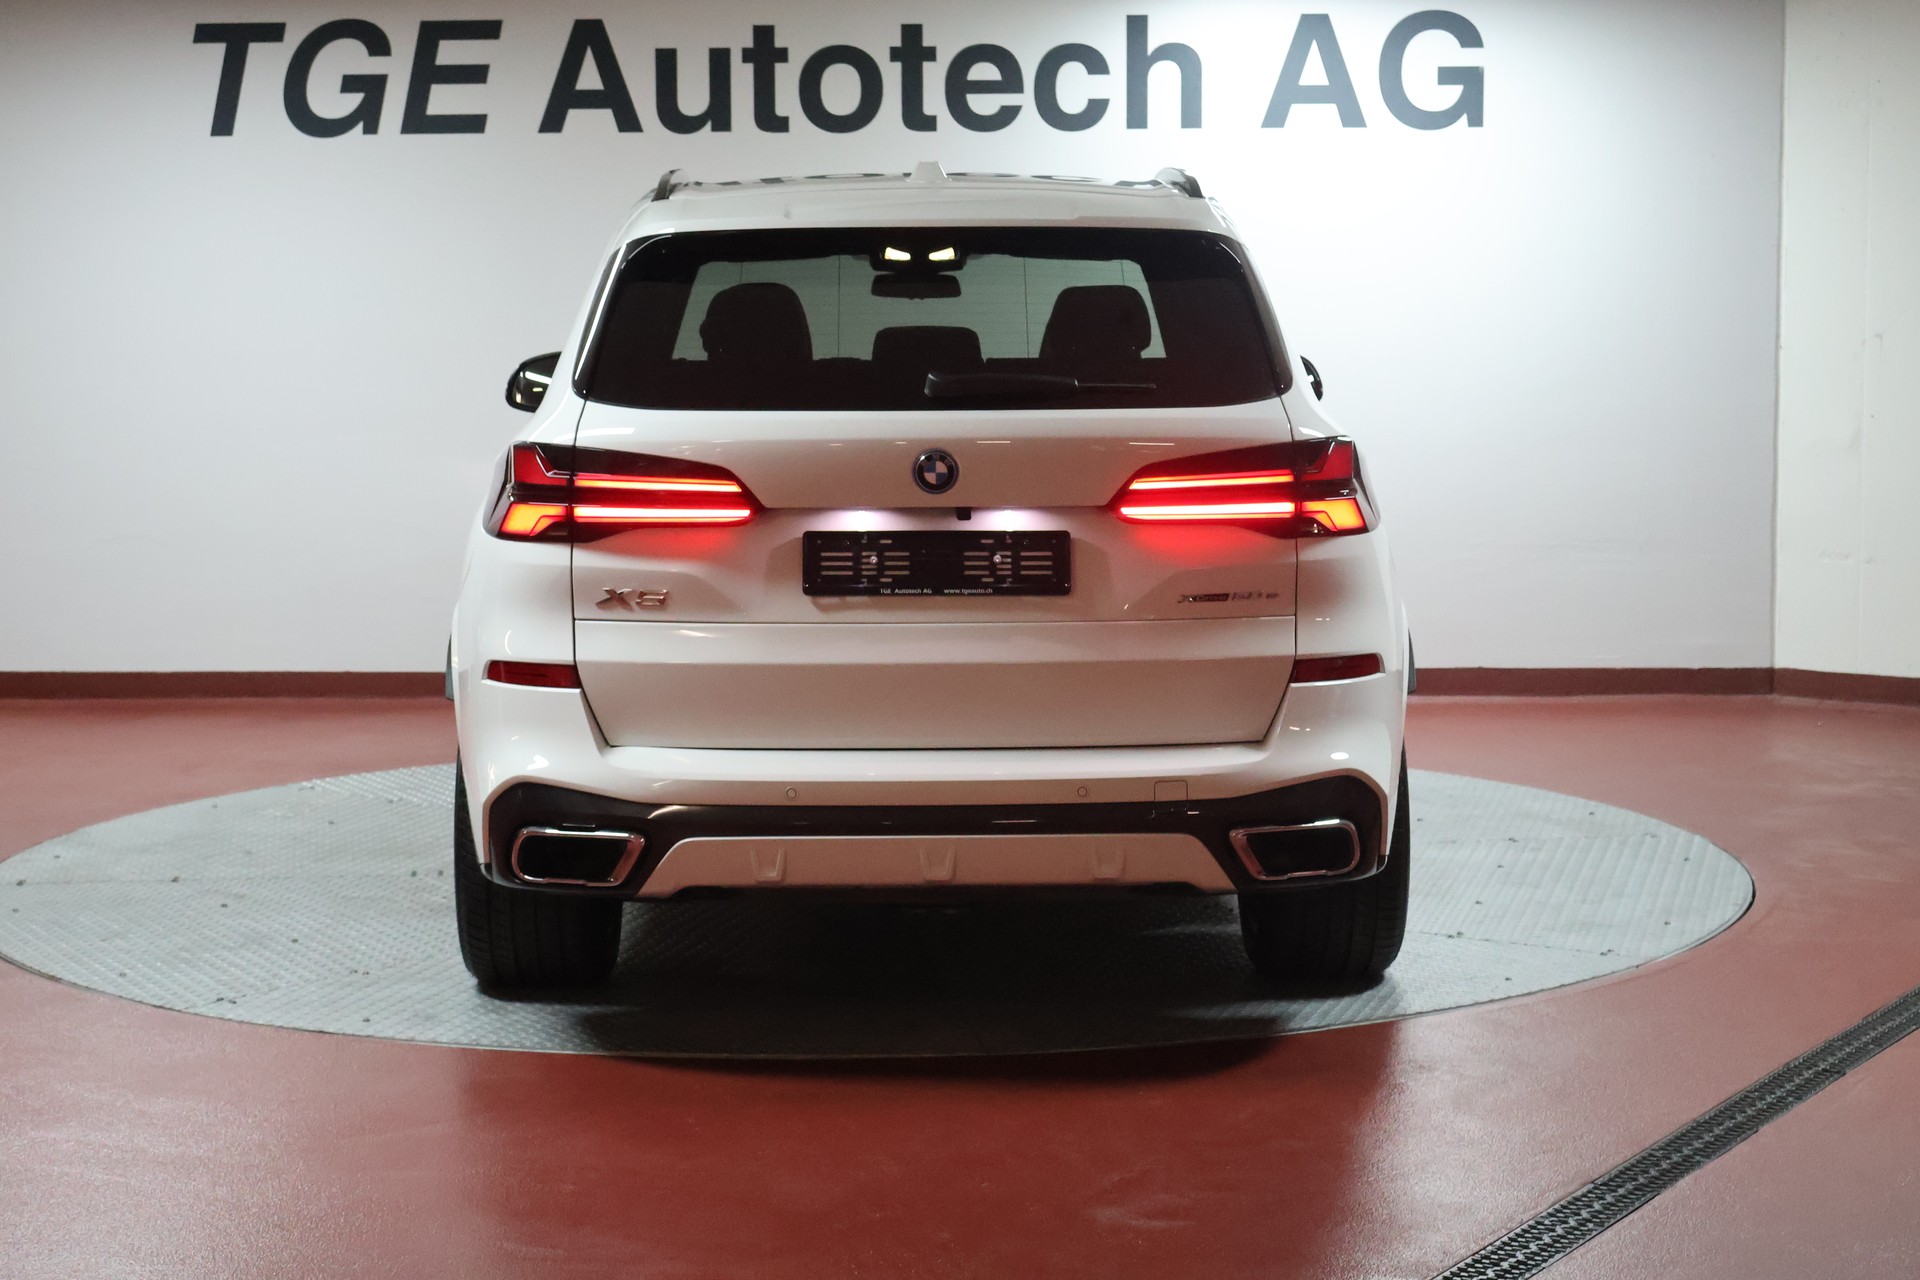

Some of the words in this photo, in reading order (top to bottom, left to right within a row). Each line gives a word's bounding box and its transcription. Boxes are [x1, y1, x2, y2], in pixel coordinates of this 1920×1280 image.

[193, 19, 503, 138] TGE
[538, 15, 1202, 134] Autotech
[1260, 9, 1485, 131] AG
[595, 587, 669, 612] X5
[943, 587, 994, 595] www.tgeauto.ch
